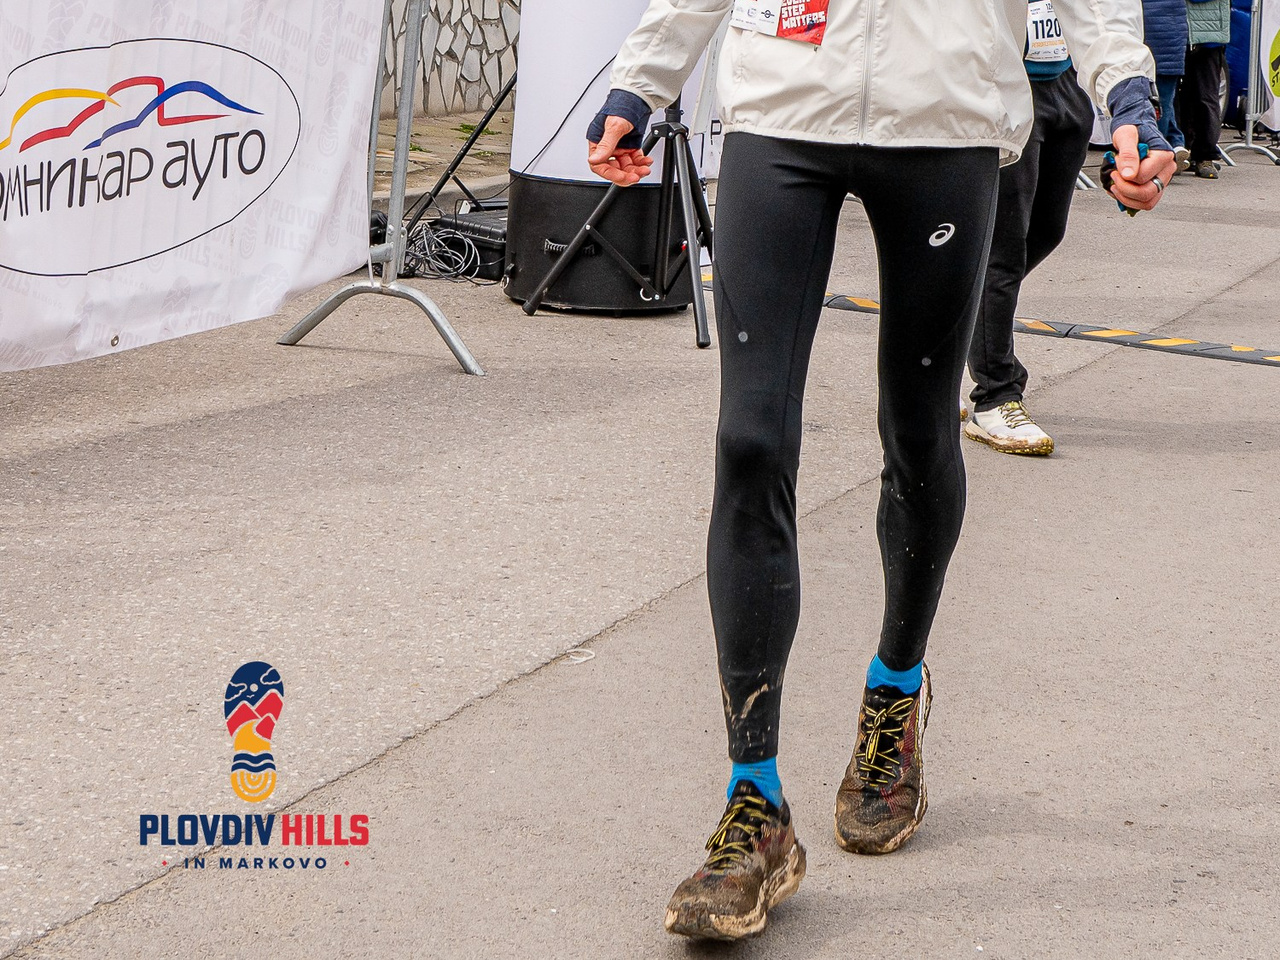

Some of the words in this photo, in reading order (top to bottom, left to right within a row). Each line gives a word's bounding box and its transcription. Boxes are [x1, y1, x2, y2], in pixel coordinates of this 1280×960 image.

[781, 3, 806, 19] STEP
[781, 11, 827, 30] MATTERS
[1032, 18, 1062, 39] 1120
